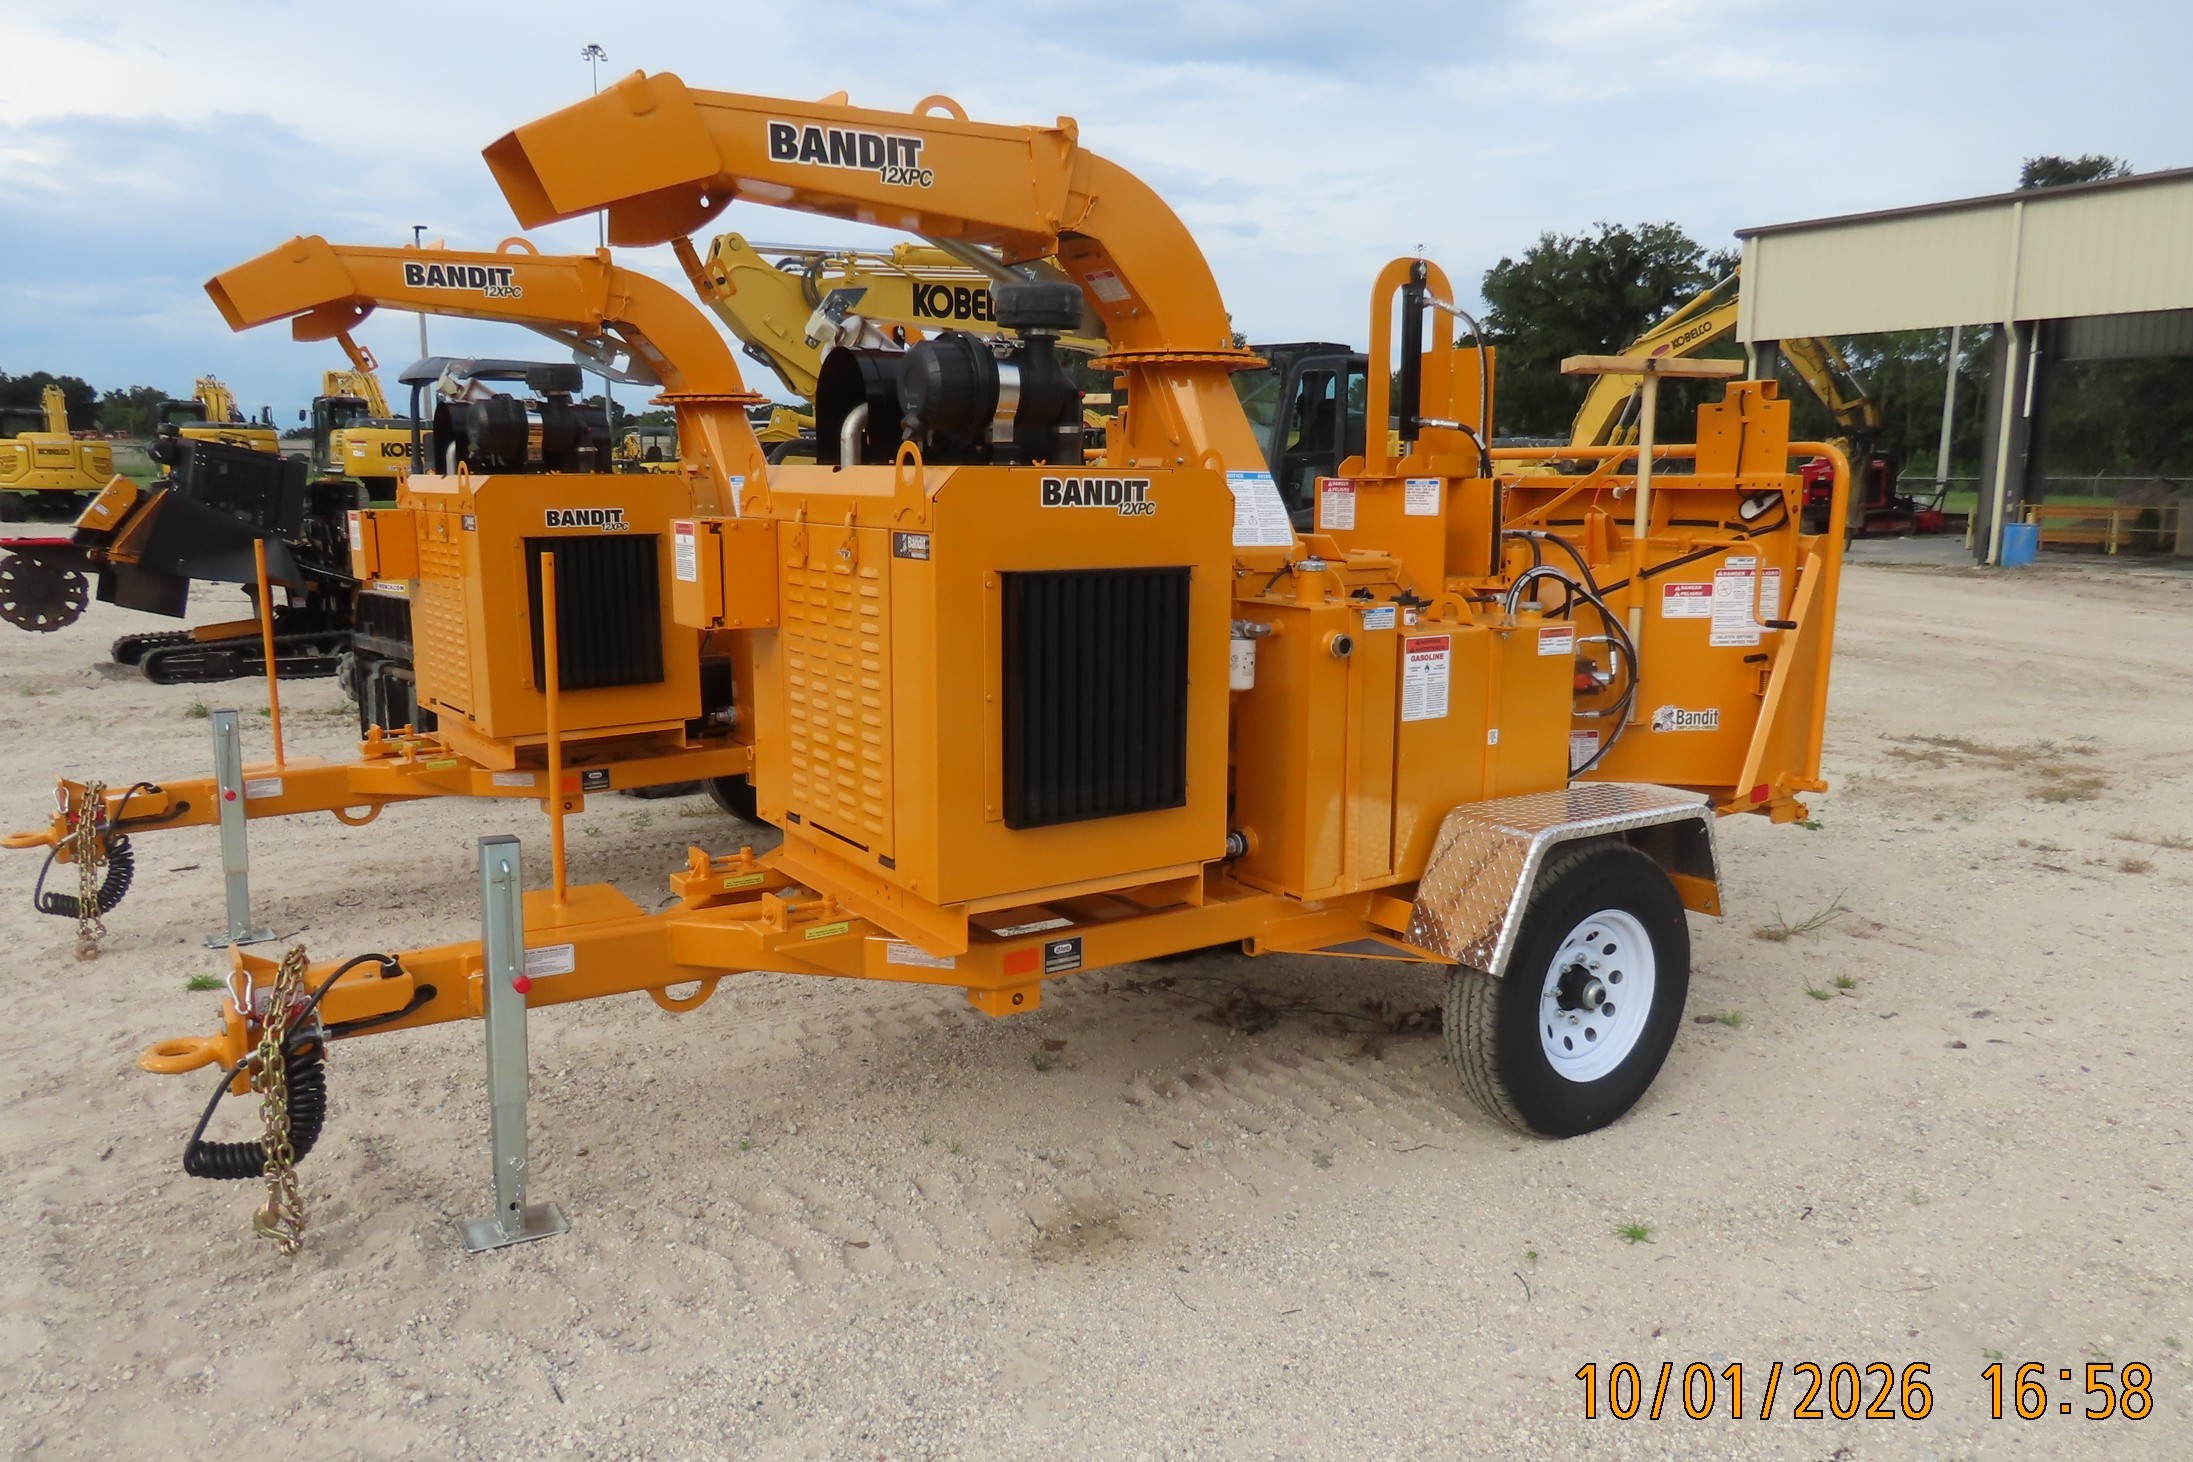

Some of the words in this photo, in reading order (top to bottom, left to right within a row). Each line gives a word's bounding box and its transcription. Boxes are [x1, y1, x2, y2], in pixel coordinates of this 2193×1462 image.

[768, 121, 922, 170] BANDIT
[879, 165, 933, 188] 12XPC
[404, 263, 513, 288] BANDIT
[483, 286, 522, 298] 12XPC
[1671, 321, 1712, 350] KOBELCO
[1042, 479, 1149, 506] BANDIT
[546, 509, 623, 526] BANDIT
[1117, 502, 1156, 515] 12XPC
[1410, 653, 1445, 662] GASOLINE
[1676, 709, 1719, 725] Bandit
